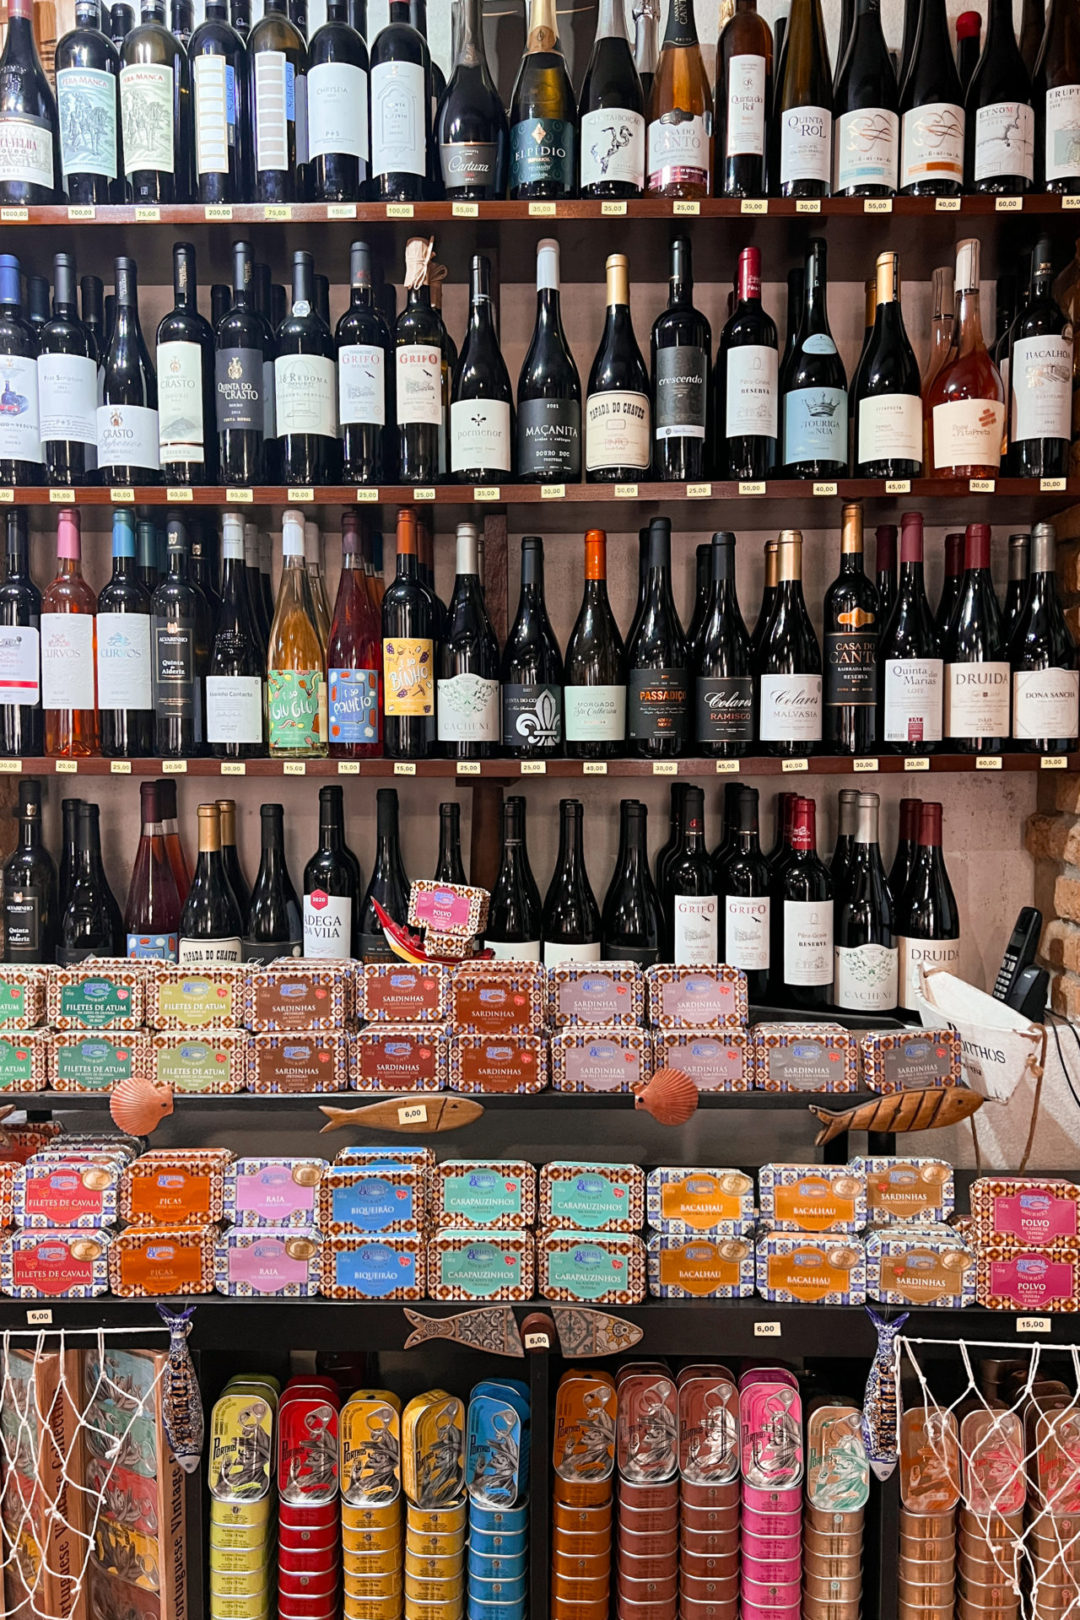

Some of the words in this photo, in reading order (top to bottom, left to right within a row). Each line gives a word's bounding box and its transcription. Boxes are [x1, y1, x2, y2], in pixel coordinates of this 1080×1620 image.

[801, 124, 827, 139] ROL
[448, 154, 489, 173] Cartuxa
[868, 202, 887, 210] 55,00
[342, 353, 380, 366] GRIFO
[399, 353, 438, 366] GRIFO
[160, 379, 196, 390] CRASTO
[658, 373, 704, 388] crescendo
[218, 382, 240, 394] QUINTA
[241, 382, 252, 391] DO
[225, 390, 259, 402] CRASTO
[590, 402, 611, 421] TAPADA
[612, 402, 621, 413] DO
[622, 402, 646, 421] CHAVES
[103, 428, 134, 440] CRASTO
[457, 427, 503, 442] pormenor
[525, 423, 579, 439] MAÇANITA
[888, 483, 906, 491] 45,00
[1042, 480, 1061, 488] 30,00
[835, 642, 861, 652] CASA
[162, 658, 184, 668] Quinta
[892, 666, 928, 678] Quinta
[903, 675, 937, 686] Marias
[955, 671, 1009, 687] DRUIDA
[704, 690, 752, 708] Colares
[769, 688, 819, 708] Colares
[1025, 691, 1048, 700] DONA
[1049, 690, 1076, 700] SANCHA
[333, 696, 372, 715] PALHETO
[577, 700, 616, 708] MORGADO
[710, 711, 751, 721] RAMISCO
[773, 710, 819, 720] MALVASIA
[718, 762, 735, 770] 45,00
[432, 908, 453, 919] POLVO
[678, 902, 716, 915] GRIFO
[728, 903, 767, 916] GRIFO
[303, 915, 342, 928] ADEGA
[8, 927, 30, 936] Quinta
[314, 928, 341, 939] VILA
[183, 949, 203, 963] TAPADA
[205, 949, 215, 961] DO
[215, 949, 239, 962] CHAVES
[382, 993, 425, 1003] SARDINHAS
[66, 1003, 93, 1012] FILETES
[94, 1003, 105, 1012] DE
[105, 1003, 127, 1012] ATUM
[163, 1002, 191, 1011] FILETES
[193, 1002, 203, 1010] DE
[204, 1002, 226, 1010] ATUM
[272, 1004, 316, 1013] SARDINHAS
[573, 1000, 617, 1009] SARDINHAS
[676, 1000, 722, 1009] SARDINHAS
[471, 1009, 515, 1018] SARDINHAS
[4, 1065, 26, 1073] ATUM
[64, 1065, 91, 1073] FILETES
[92, 1065, 103, 1073] DE
[104, 1065, 126, 1073] ATUM
[163, 1067, 190, 1076] FILETES
[191, 1067, 202, 1076] DE
[203, 1067, 225, 1076] ATUM
[275, 1067, 319, 1076] SARDINHAS
[376, 1062, 420, 1072] SARDINHAS
[477, 1067, 522, 1076] SARDINHAS
[580, 1067, 625, 1076] SARDINHAS
[682, 1065, 728, 1074] SARDINHAS
[783, 1065, 831, 1074] SARDINHAS
[896, 1063, 939, 1074] SARDINHAS
[405, 1109, 421, 1118] 6,00
[159, 1197, 182, 1207] PICAS
[266, 1195, 285, 1204] RAIA
[450, 1197, 515, 1207] CARAPAUZINHOS
[881, 1192, 927, 1202] SARDINHAS
[29, 1198, 57, 1208] FILETES
[58, 1198, 70, 1207] DE
[71, 1197, 101, 1208] CAVALA
[557, 1200, 623, 1212] CARAPAUZINHOS
[351, 1203, 395, 1215] BIQUEIRÃO
[680, 1203, 723, 1213] BACALHAU
[793, 1206, 837, 1217] BACALHAU
[1021, 1217, 1050, 1228] POLVO
[17, 1270, 46, 1279] FILETES
[48, 1270, 60, 1279] DE
[60, 1269, 91, 1279] CAVALA
[150, 1267, 174, 1277] PICAS
[259, 1267, 278, 1276] RAIA
[354, 1268, 398, 1280] BIQUEIRÃO
[447, 1269, 514, 1280] CARAPAUZINHOS
[679, 1270, 722, 1279] BACALHAU
[555, 1271, 622, 1284] CARAPAUZINHOS
[786, 1275, 831, 1285] BACALHAU
[896, 1276, 947, 1288] SARDINHAS
[1017, 1282, 1047, 1292] POLVO
[31, 1312, 50, 1321] 6,00
[757, 1324, 775, 1334] 6,00
[1021, 1320, 1045, 1329] 15,00
[529, 1336, 547, 1345] 6,00
[51, 1387, 66, 1471] Collection
[557, 1416, 581, 1439] PORTHOS
[213, 1436, 237, 1460] PORTHOS
[343, 1440, 367, 1463] PORTHOS
